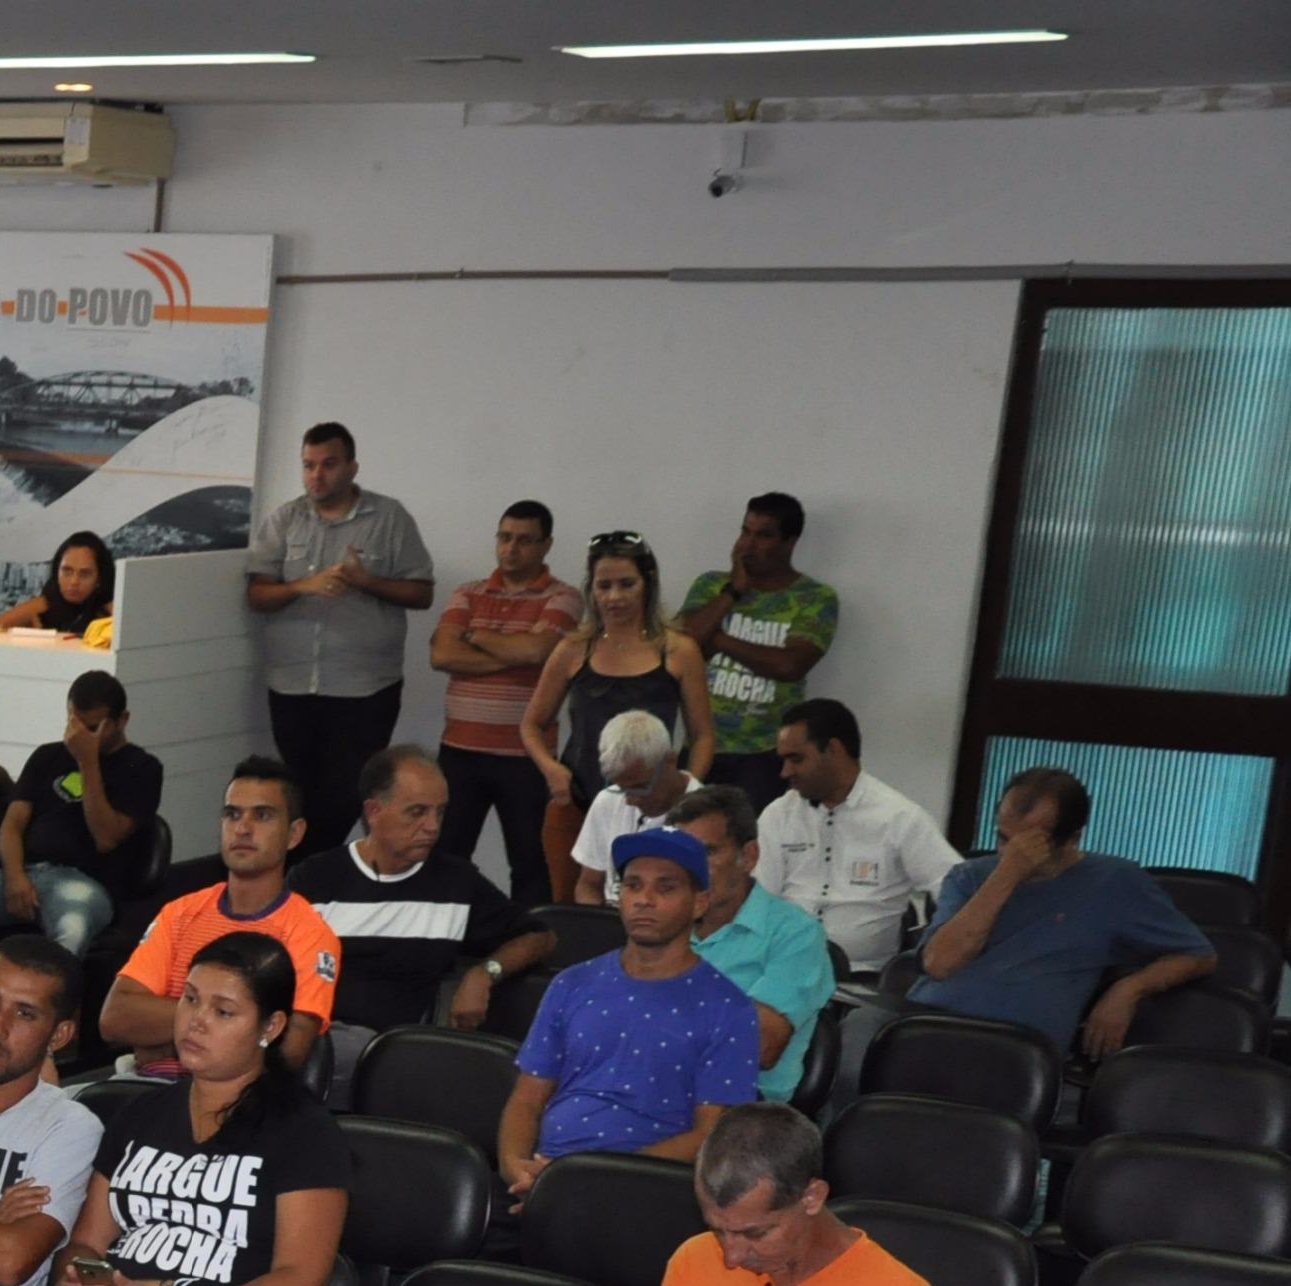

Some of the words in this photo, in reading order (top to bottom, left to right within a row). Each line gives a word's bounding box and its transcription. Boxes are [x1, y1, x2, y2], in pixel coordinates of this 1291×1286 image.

[15, 288, 58, 324] DO
[68, 287, 154, 328] POVO
[118, 1222, 238, 1284] ROCHA
